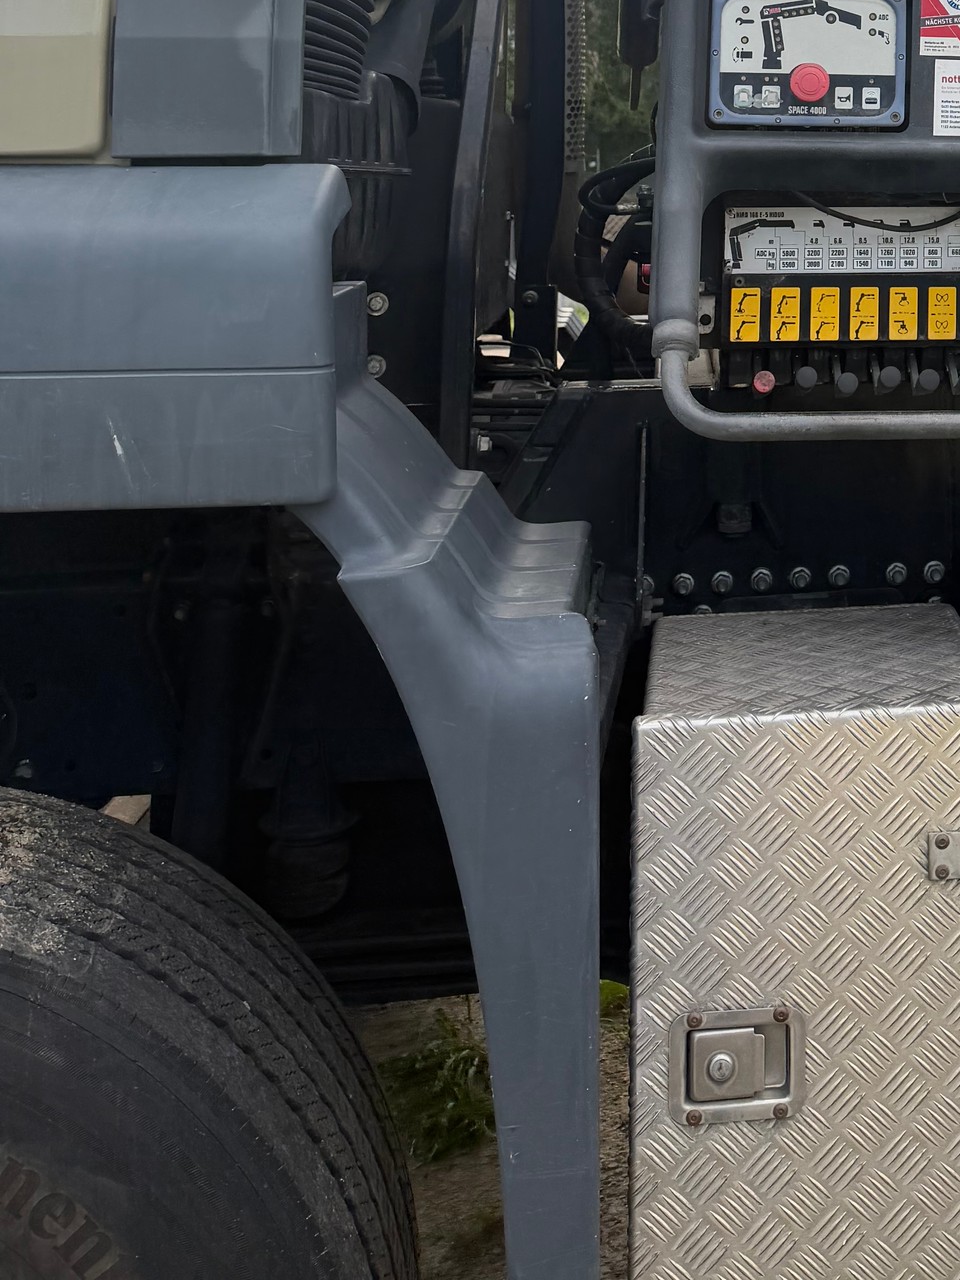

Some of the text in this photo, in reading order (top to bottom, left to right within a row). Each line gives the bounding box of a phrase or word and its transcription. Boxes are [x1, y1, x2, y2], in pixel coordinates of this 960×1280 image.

[925, 17, 953, 25] NÄCHSTE
[788, 106, 827, 114] SPACE 4000
[768, 250, 775, 258] kg
[768, 262, 775, 270] kg
